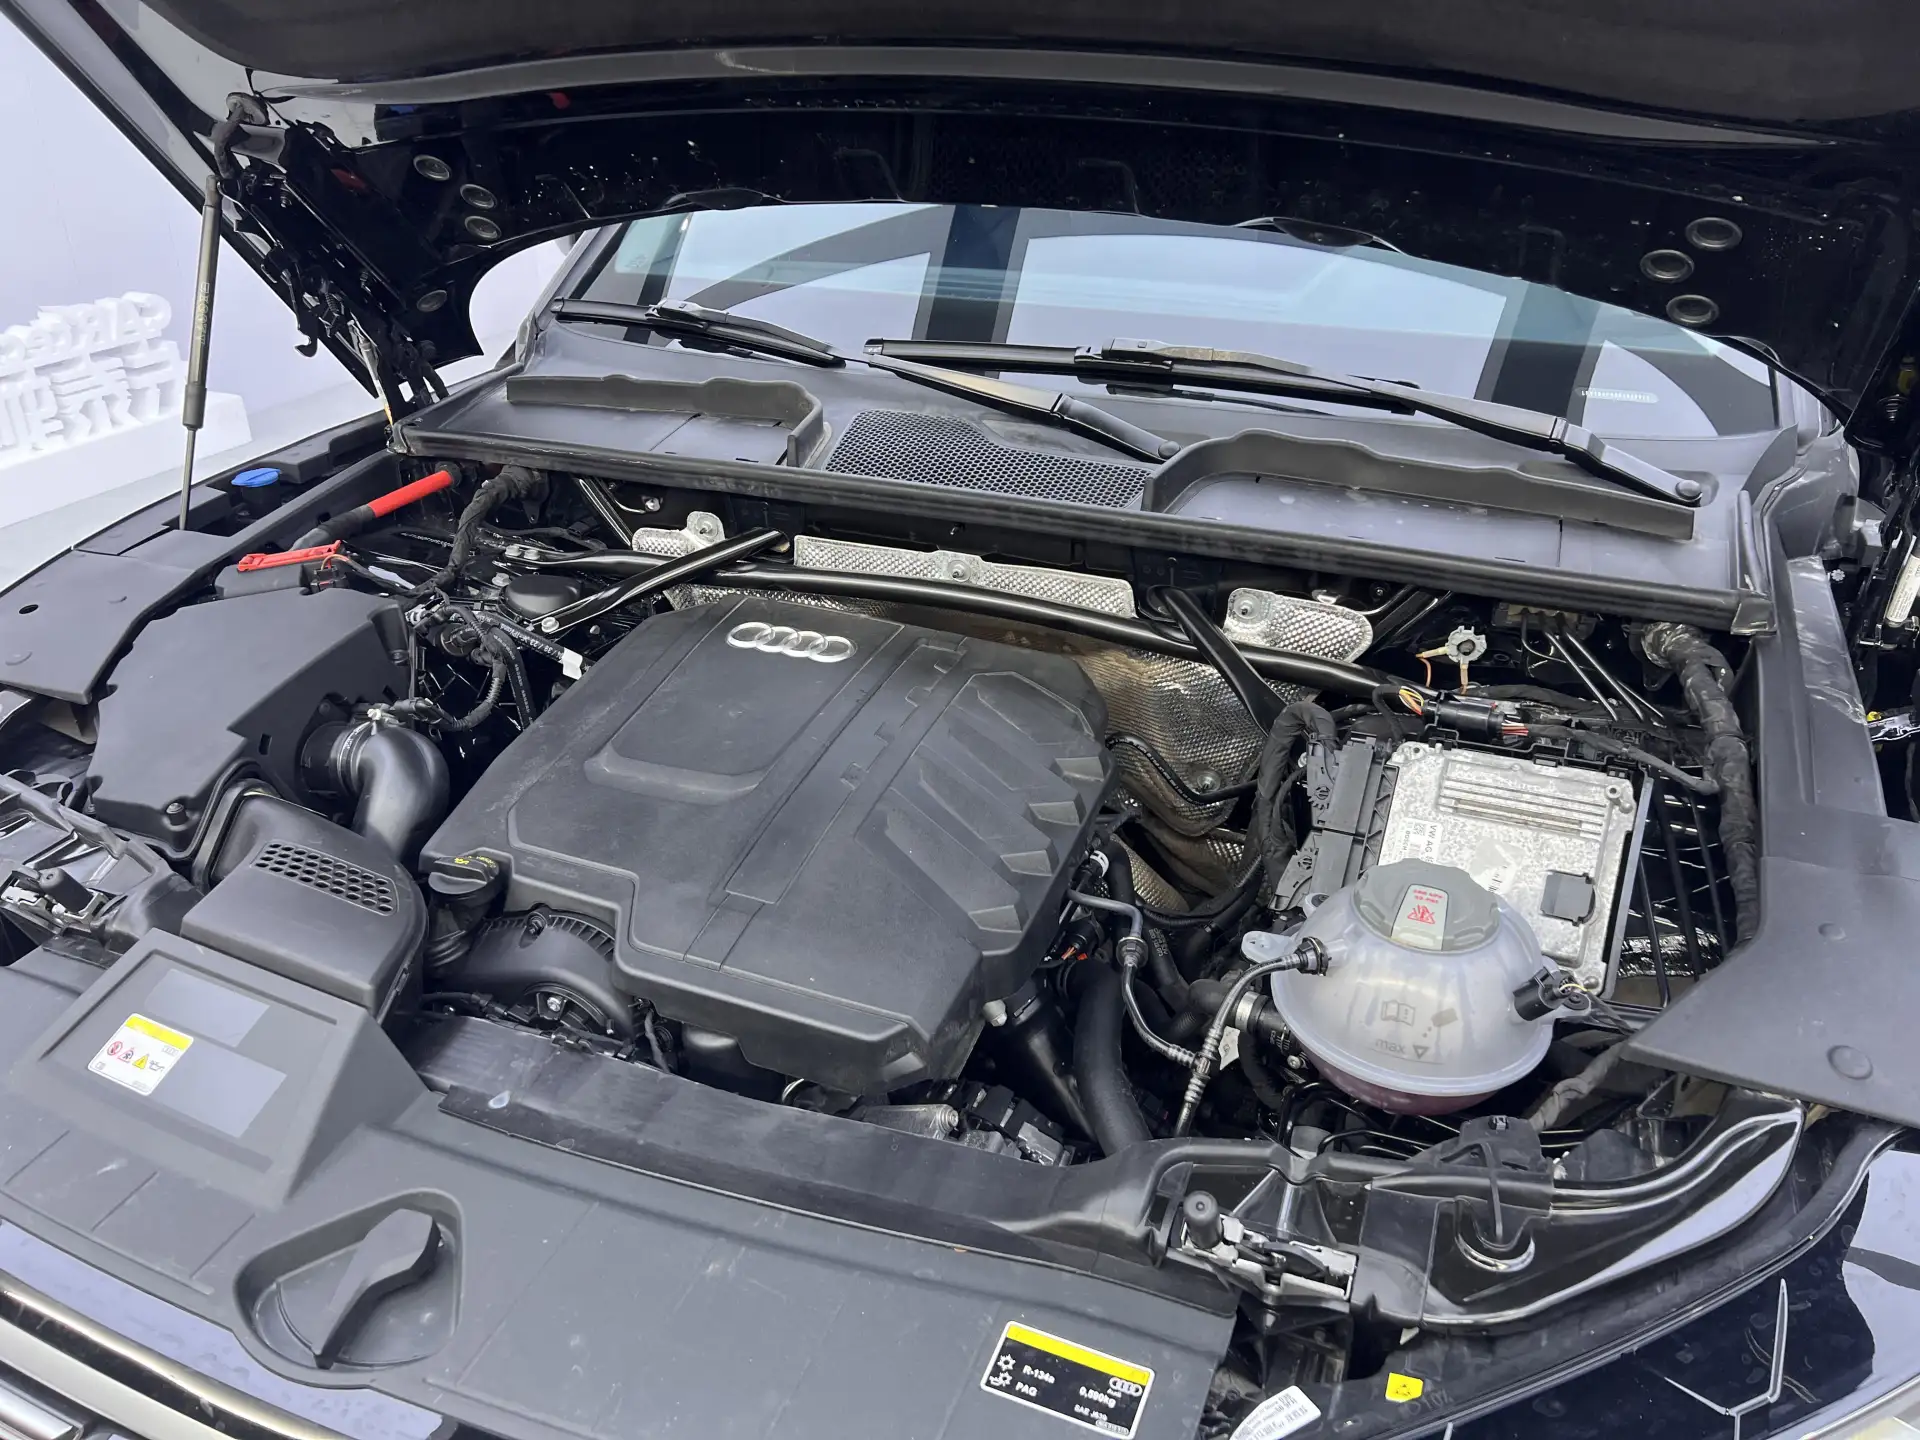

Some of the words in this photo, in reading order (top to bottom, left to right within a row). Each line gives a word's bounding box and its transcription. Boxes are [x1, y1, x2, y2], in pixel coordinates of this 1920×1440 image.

[1428, 825, 1437, 839] VW
[1425, 840, 1433, 853] AG
[1374, 1038, 1407, 1055] max
[1022, 1364, 1056, 1384] R-134a
[1014, 1381, 1038, 1397] PAG
